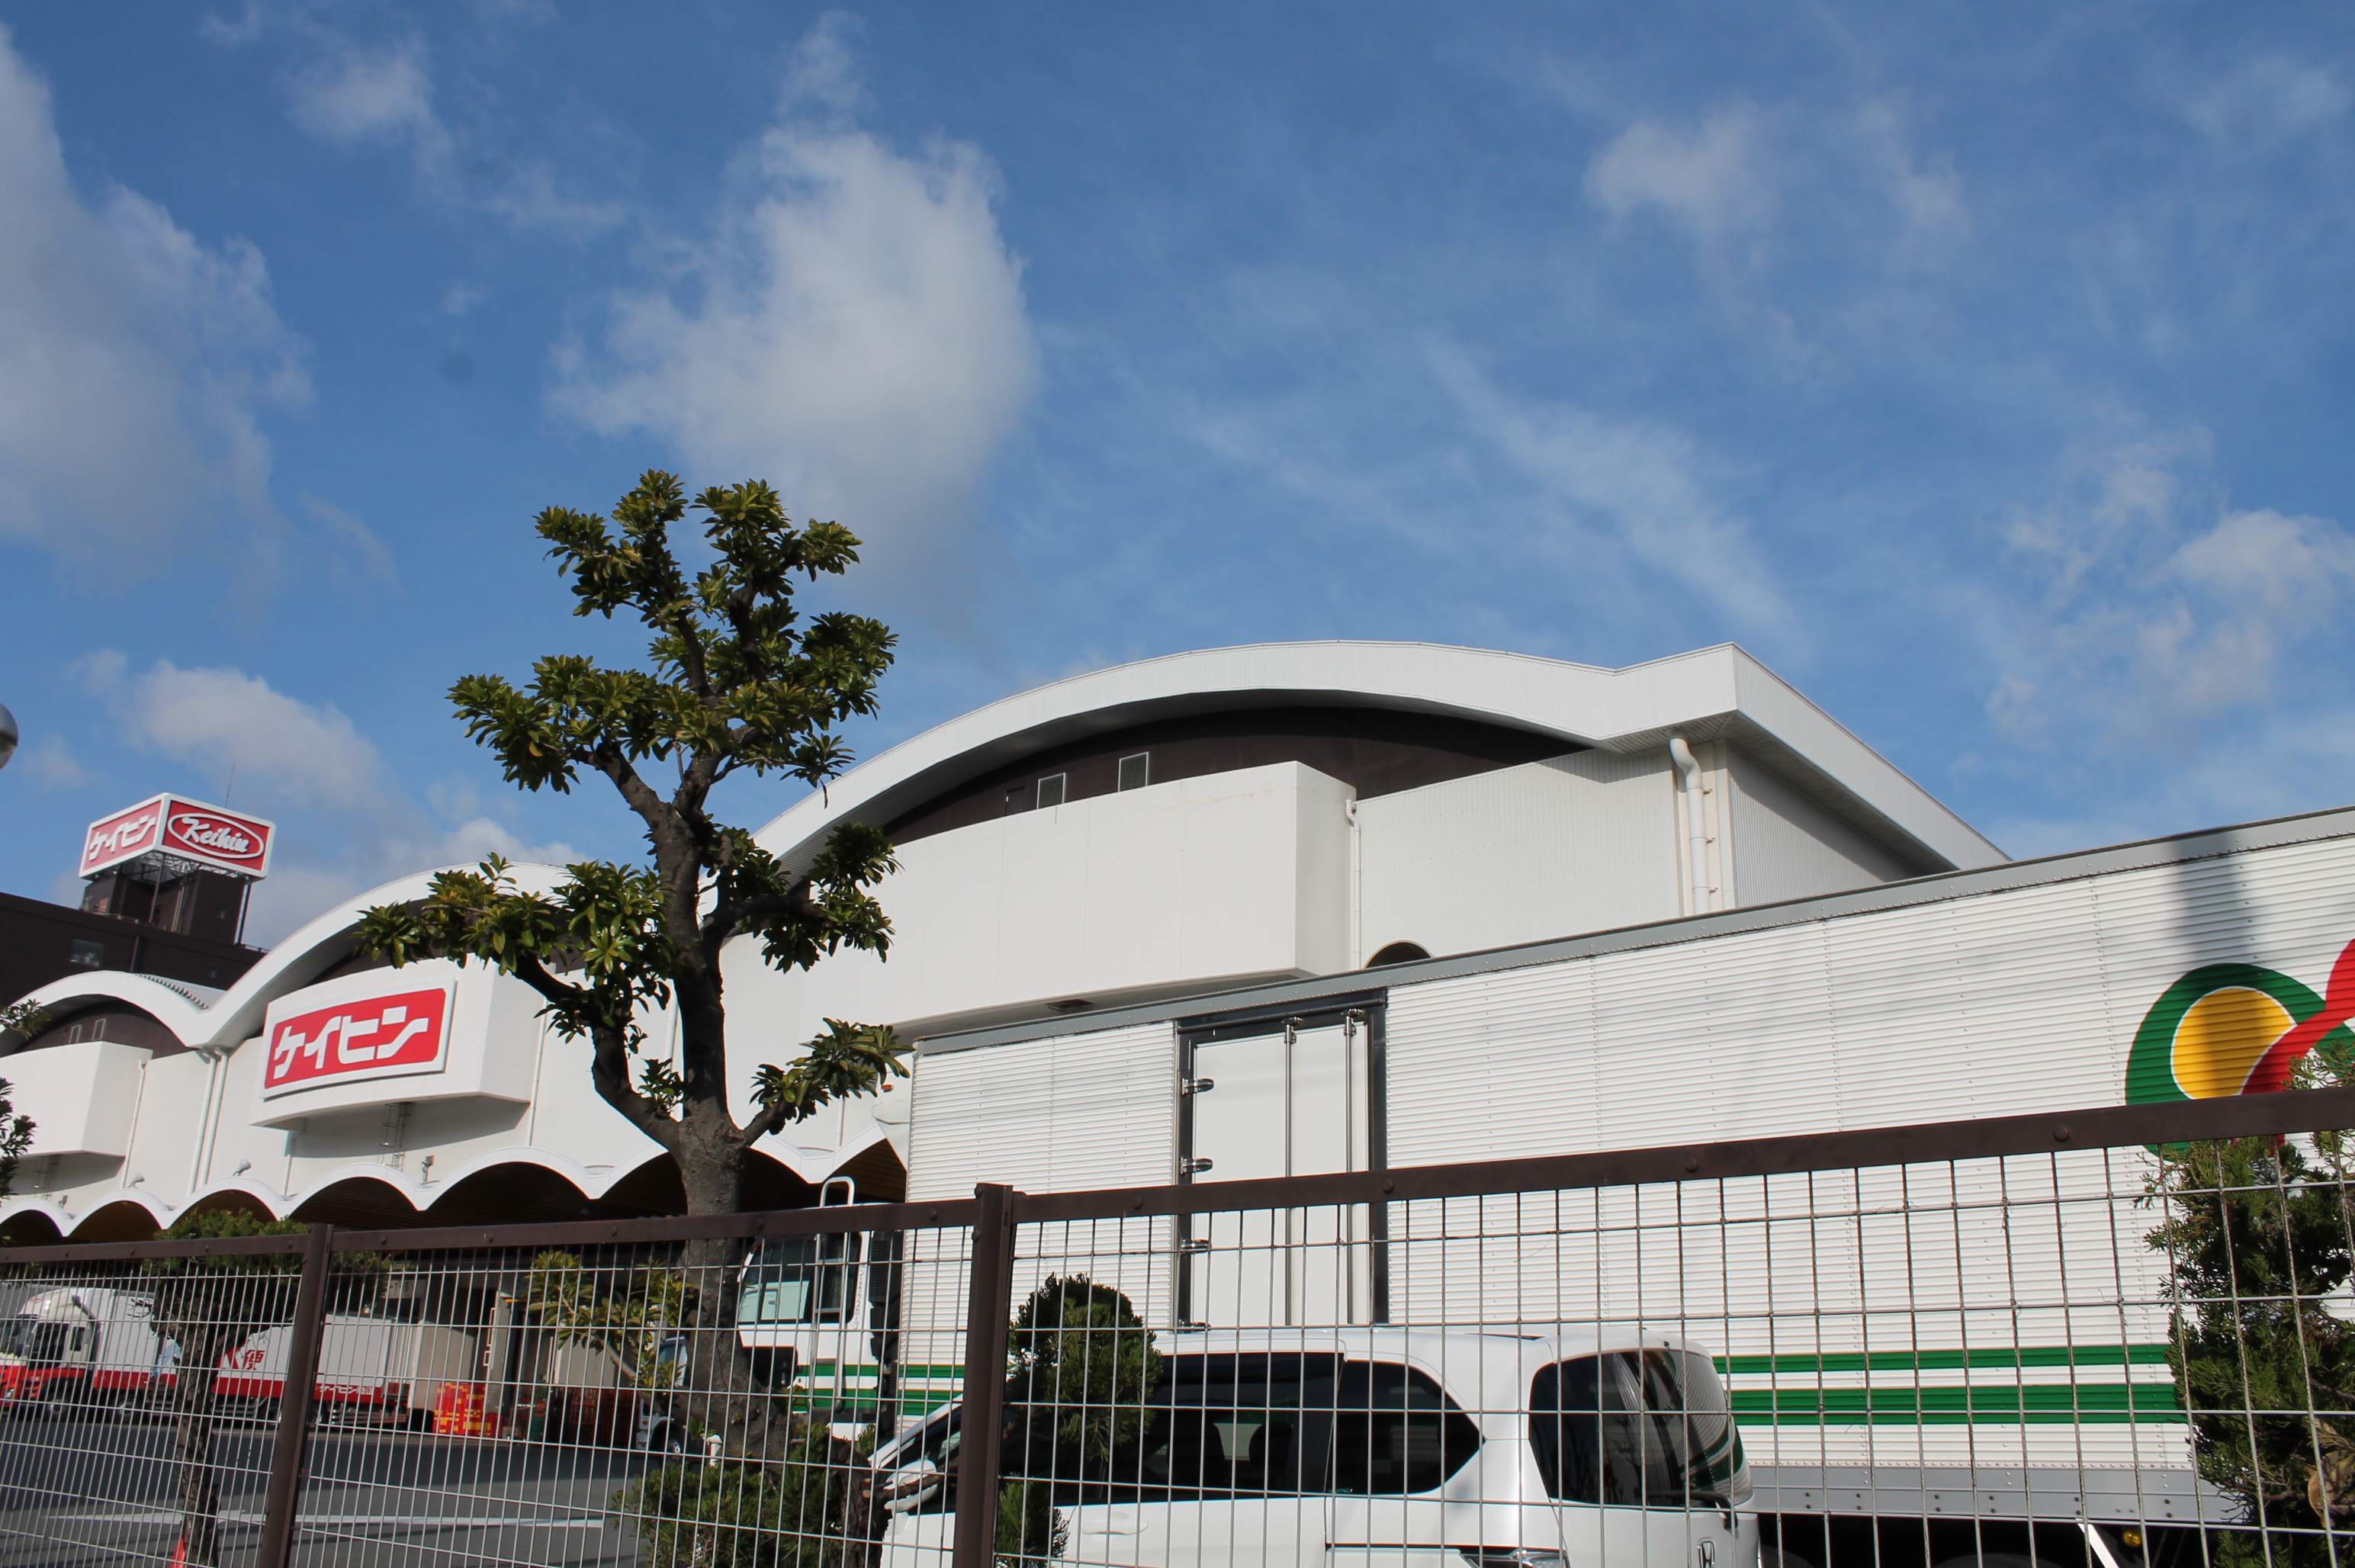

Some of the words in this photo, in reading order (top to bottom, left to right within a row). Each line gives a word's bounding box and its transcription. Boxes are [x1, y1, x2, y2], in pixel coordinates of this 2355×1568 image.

[88, 815, 156, 861] ケイヒン
[182, 817, 250, 853] Keihin
[273, 1005, 429, 1080] ケイヒン
